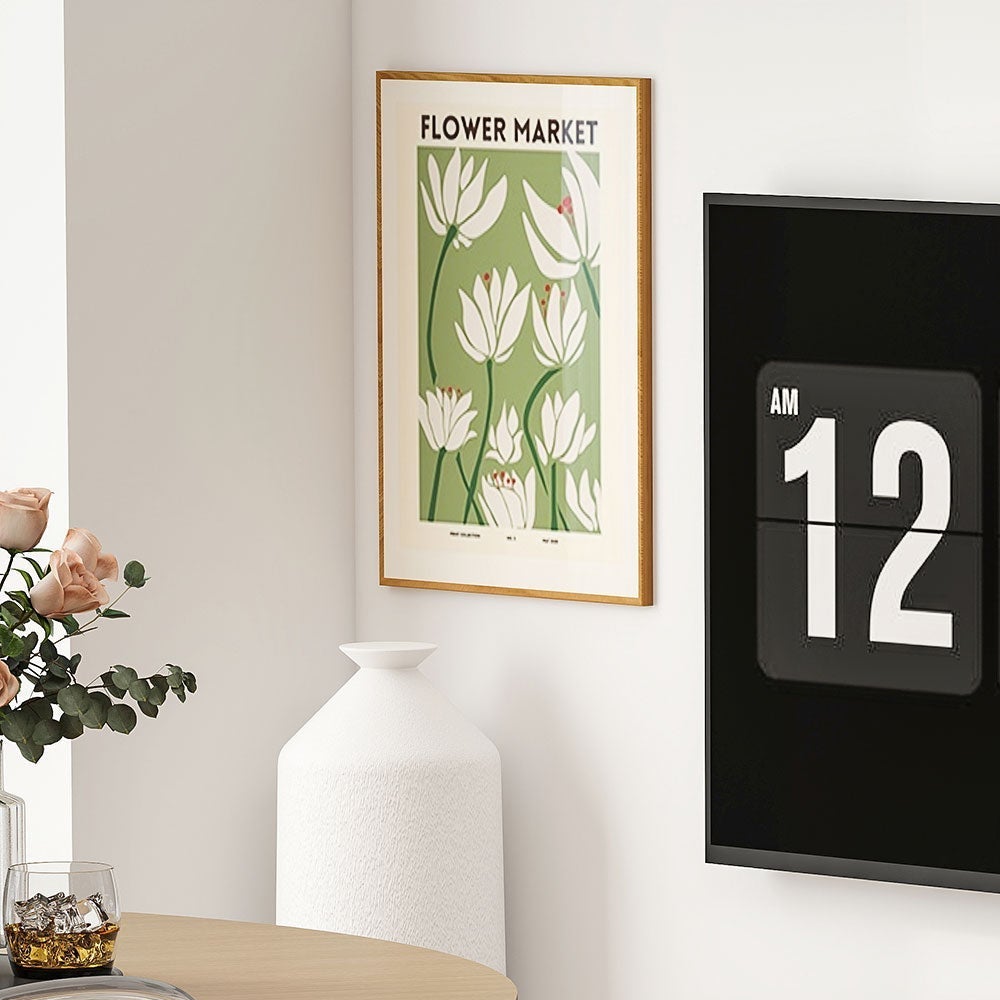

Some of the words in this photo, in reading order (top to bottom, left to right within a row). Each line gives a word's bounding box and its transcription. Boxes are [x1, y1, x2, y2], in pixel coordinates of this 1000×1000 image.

[421, 115, 506, 143] FLOWER
[514, 118, 599, 145] MARKET
[770, 388, 799, 416] AM
[784, 417, 953, 648] 12
